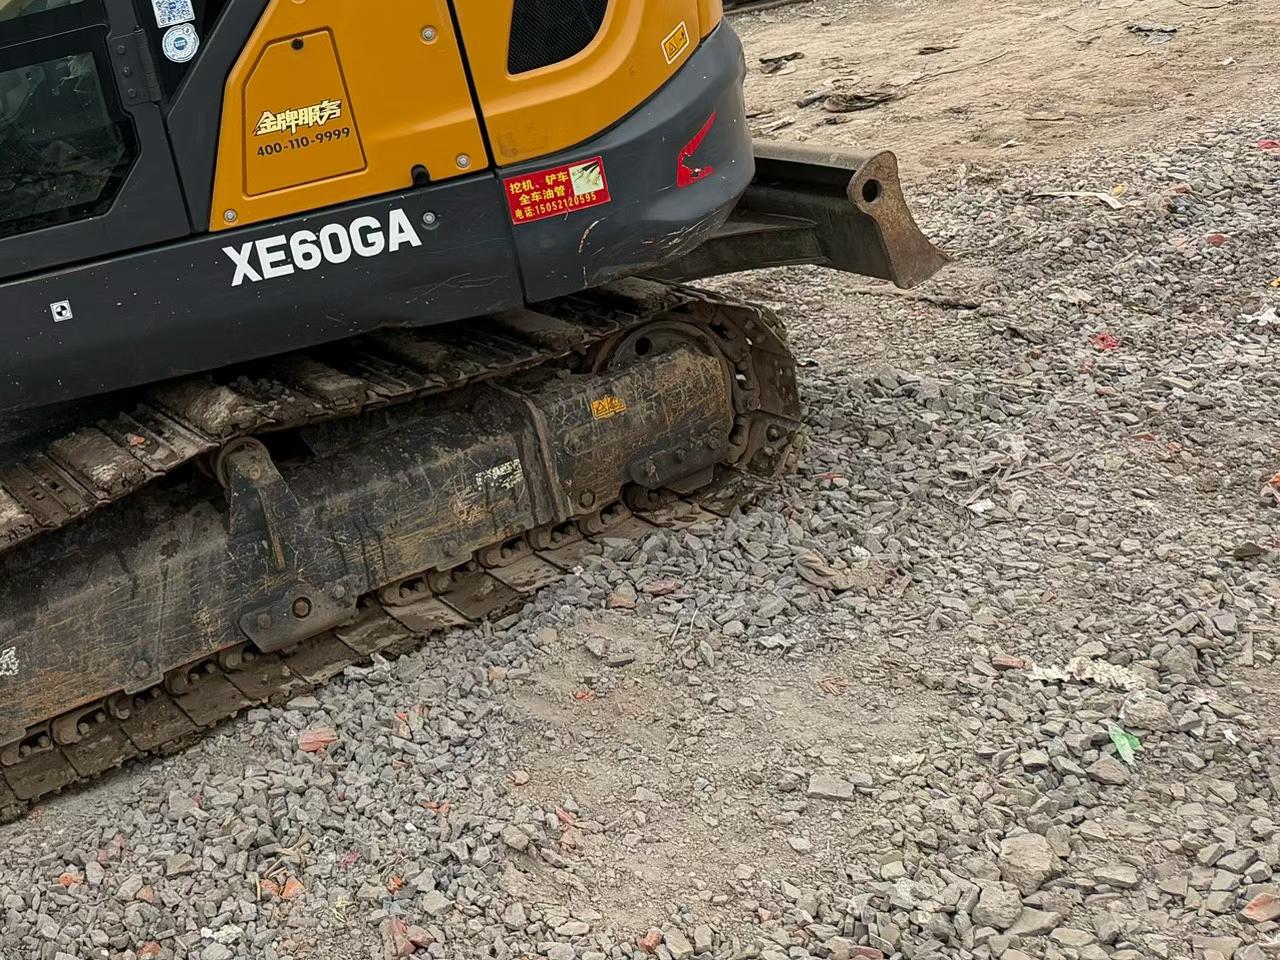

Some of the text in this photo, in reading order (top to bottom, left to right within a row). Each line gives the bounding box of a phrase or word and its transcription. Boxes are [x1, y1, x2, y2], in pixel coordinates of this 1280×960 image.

[253, 99, 342, 137] 金牌服务
[257, 127, 351, 157] 400-110-9999
[519, 185, 567, 206] 全车油管
[222, 208, 423, 287] XE60GA
